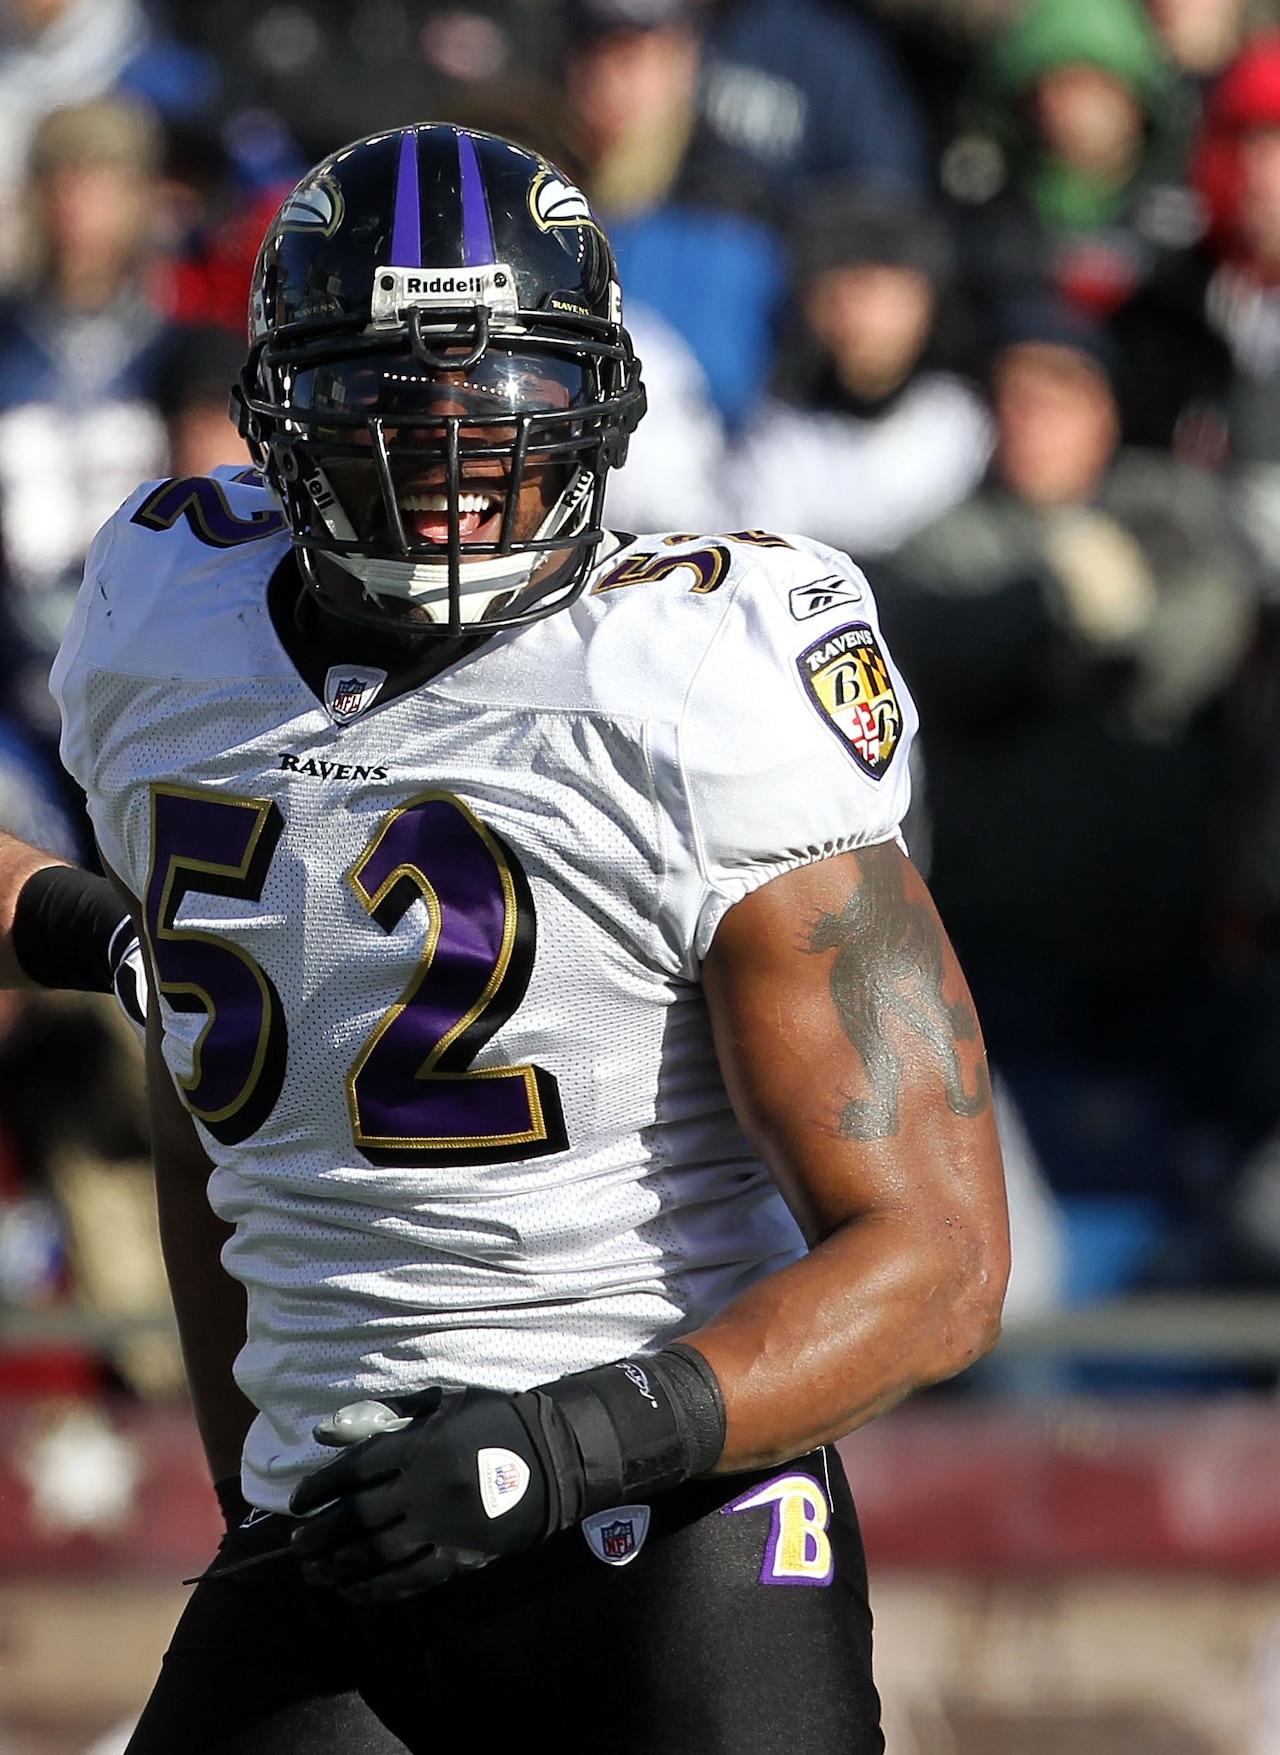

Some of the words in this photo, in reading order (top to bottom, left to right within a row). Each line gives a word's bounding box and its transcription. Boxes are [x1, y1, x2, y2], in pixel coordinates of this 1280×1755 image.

[407, 276, 481, 293] Riddell
[550, 299, 590, 316] RAVENS
[129, 467, 292, 549] 2
[805, 629, 874, 671] RAVENS
[279, 753, 389, 782] RAVENS
[142, 782, 570, 1168] 52
[722, 1472, 835, 1586] B
